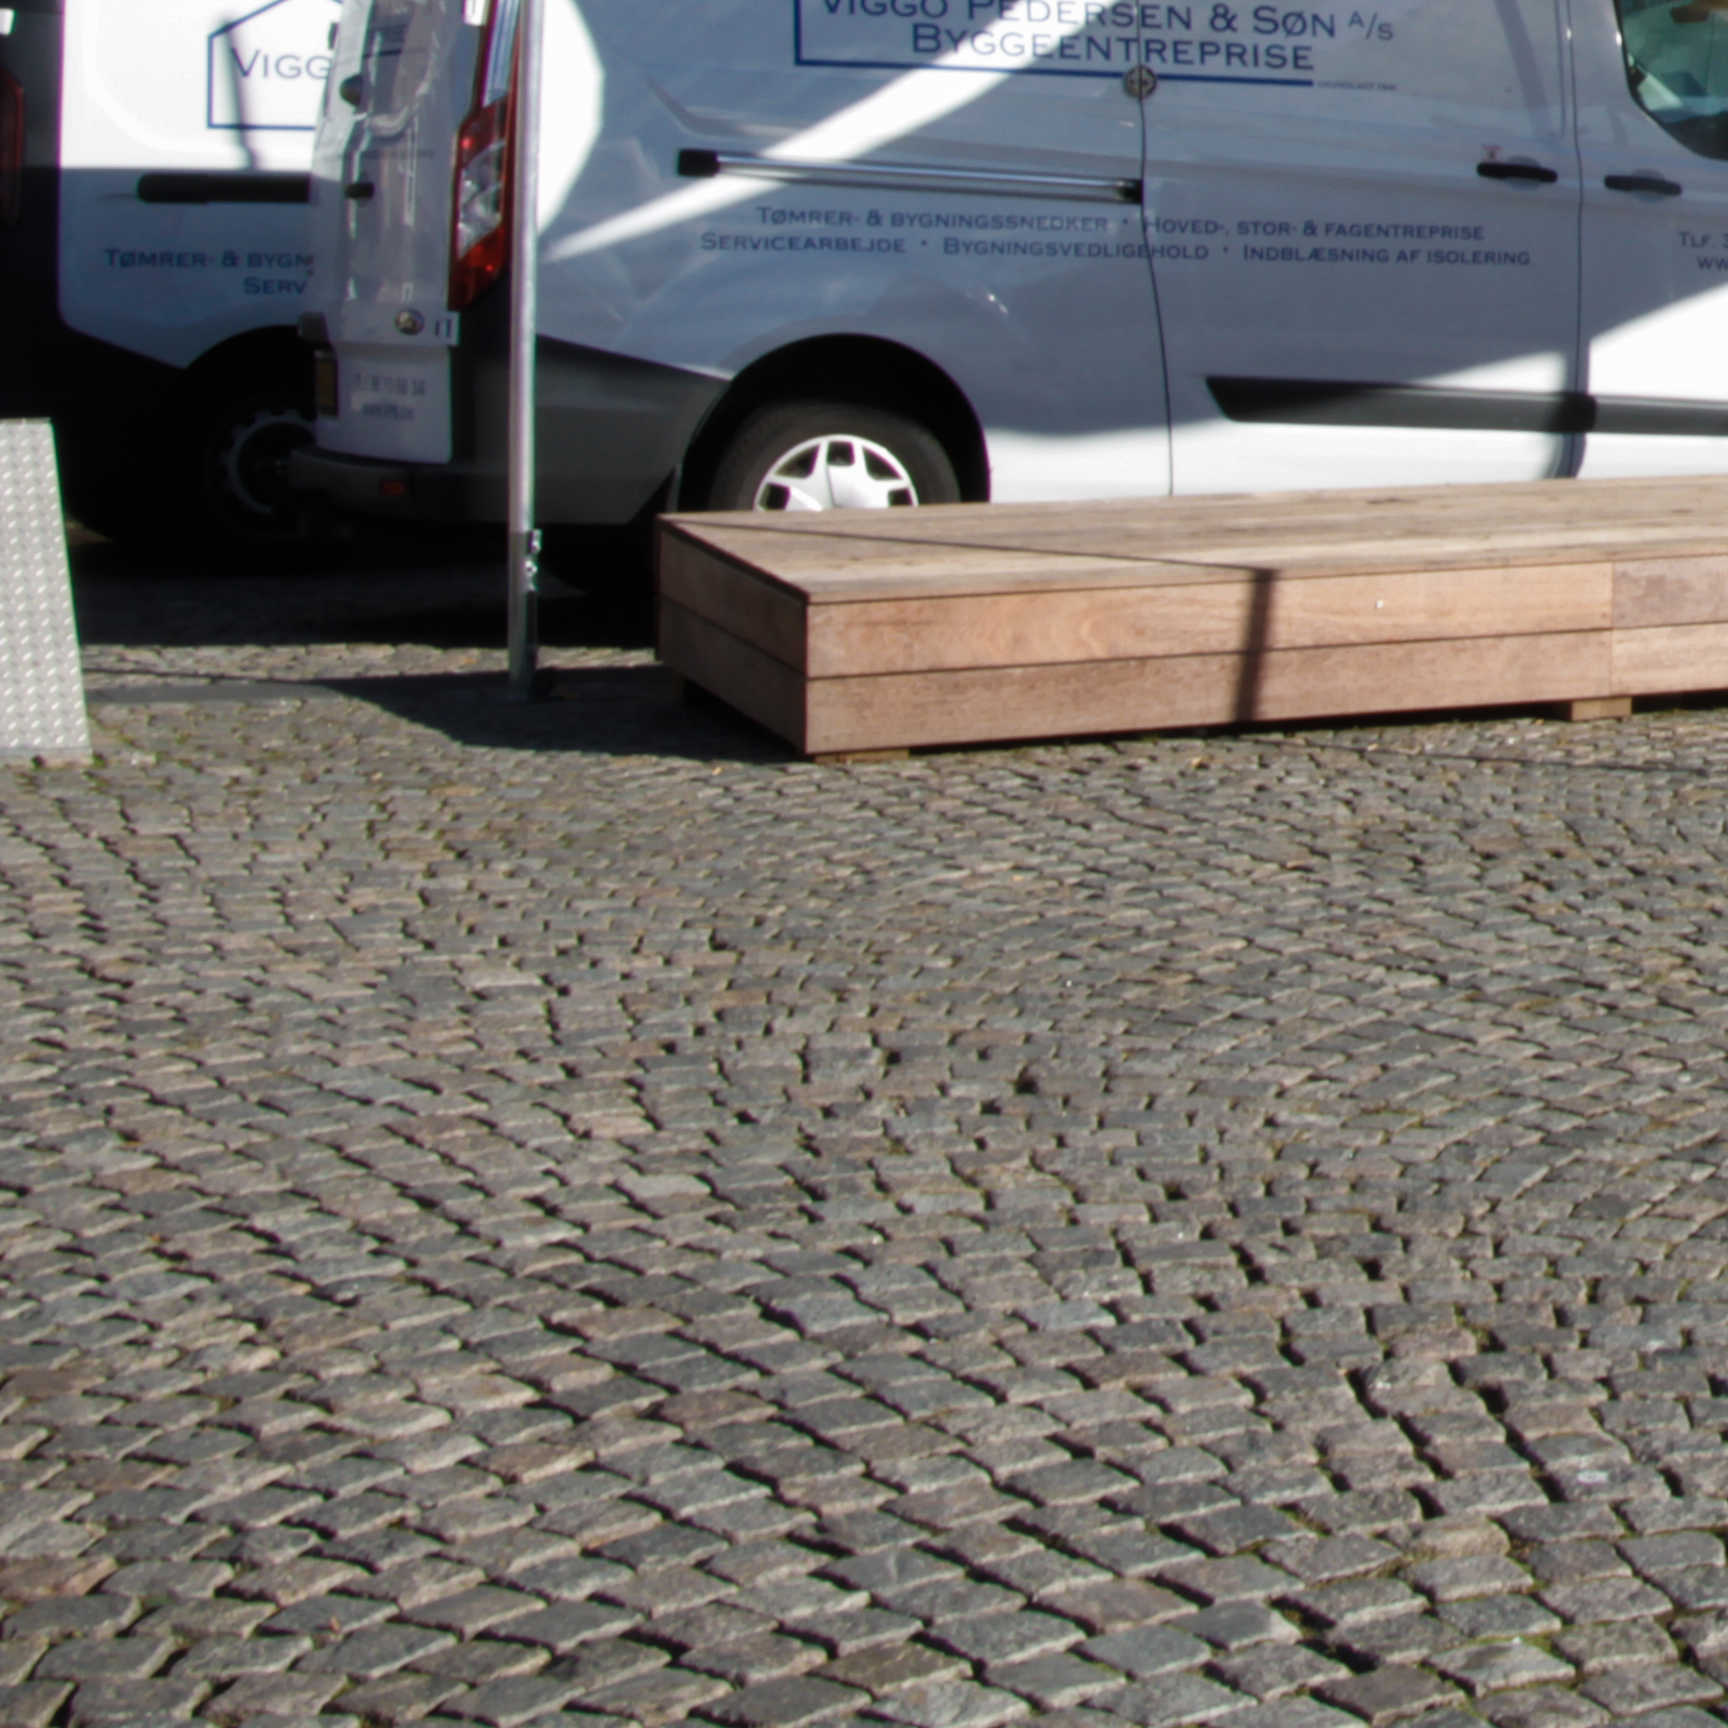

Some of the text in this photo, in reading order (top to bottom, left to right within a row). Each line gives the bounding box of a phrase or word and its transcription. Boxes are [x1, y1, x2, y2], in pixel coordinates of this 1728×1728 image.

[1209, 2, 1239, 33] &
[1253, 5, 1336, 39] SØN
[1347, 9, 1394, 41] A/S
[229, 46, 334, 80] VIGG
[911, 22, 1315, 70] BYGGEENTREPRISE
[866, 208, 884, 228] &
[1303, 219, 1318, 238] &
[1323, 221, 1487, 241] FAGENTREPRISE
[221, 250, 239, 269] &
[700, 231, 907, 255] SERVICEARBEJDE
[1395, 247, 1422, 265] AF
[1426, 248, 1533, 268] ISOLERING
